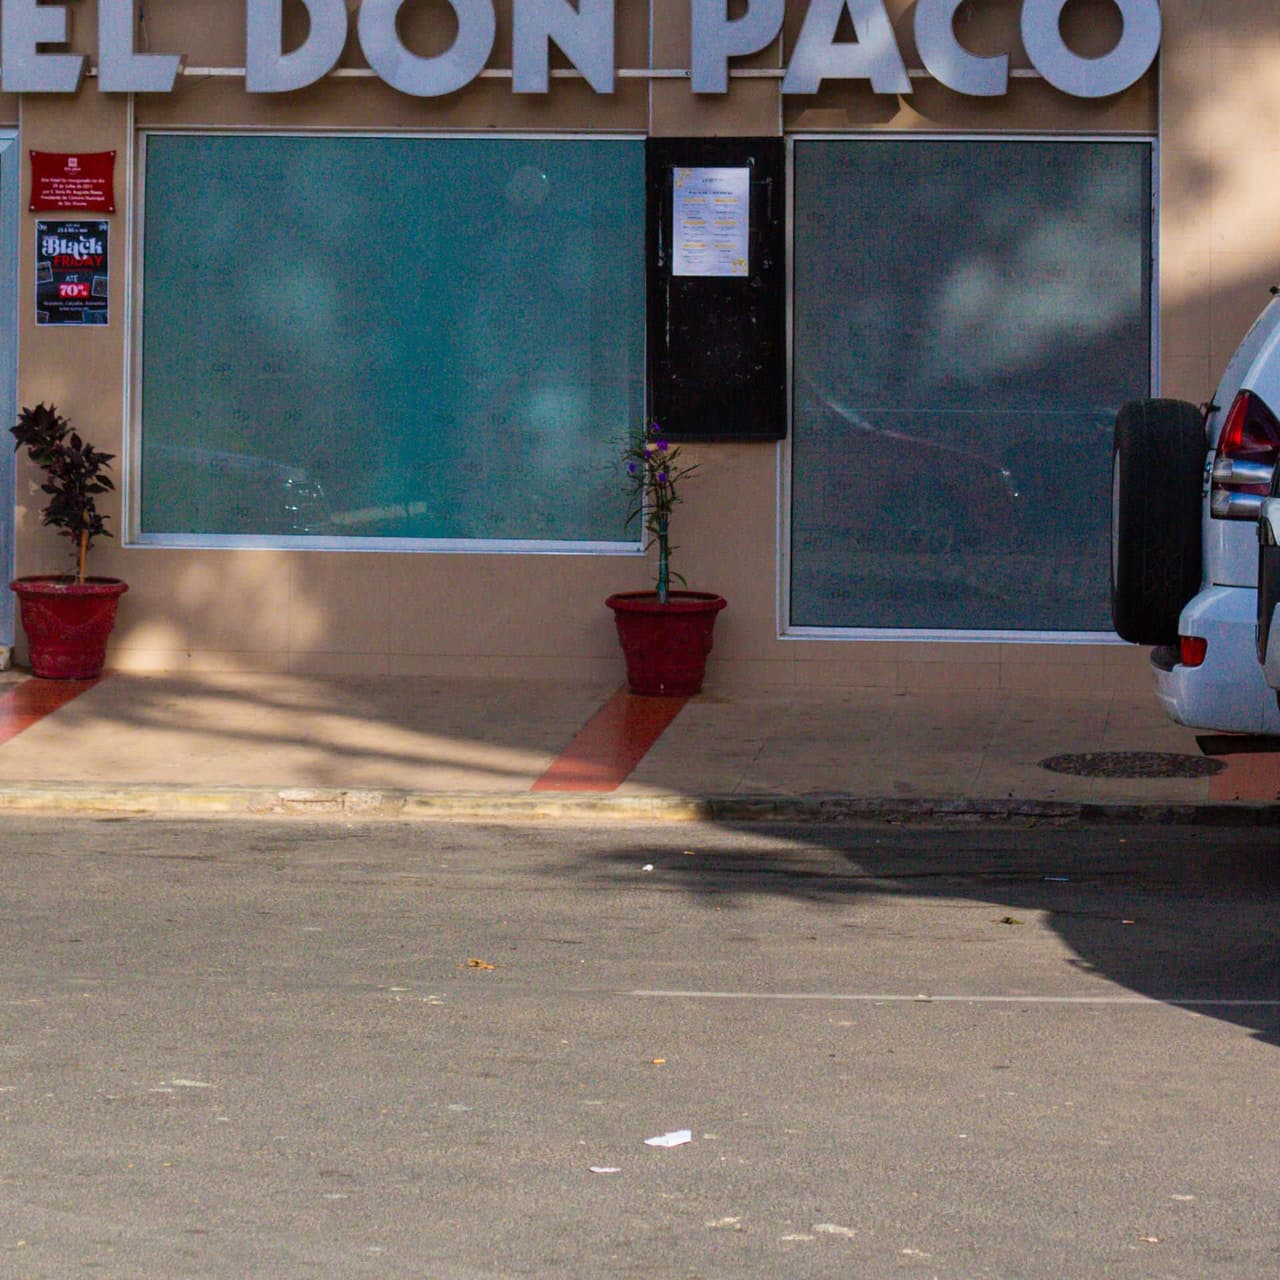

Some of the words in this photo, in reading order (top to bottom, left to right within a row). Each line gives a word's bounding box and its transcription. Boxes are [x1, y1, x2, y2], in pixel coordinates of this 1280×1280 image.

[41, 234, 103, 260] Black
[53, 255, 104, 267] FRIDAY
[60, 284, 88, 296] 70%
